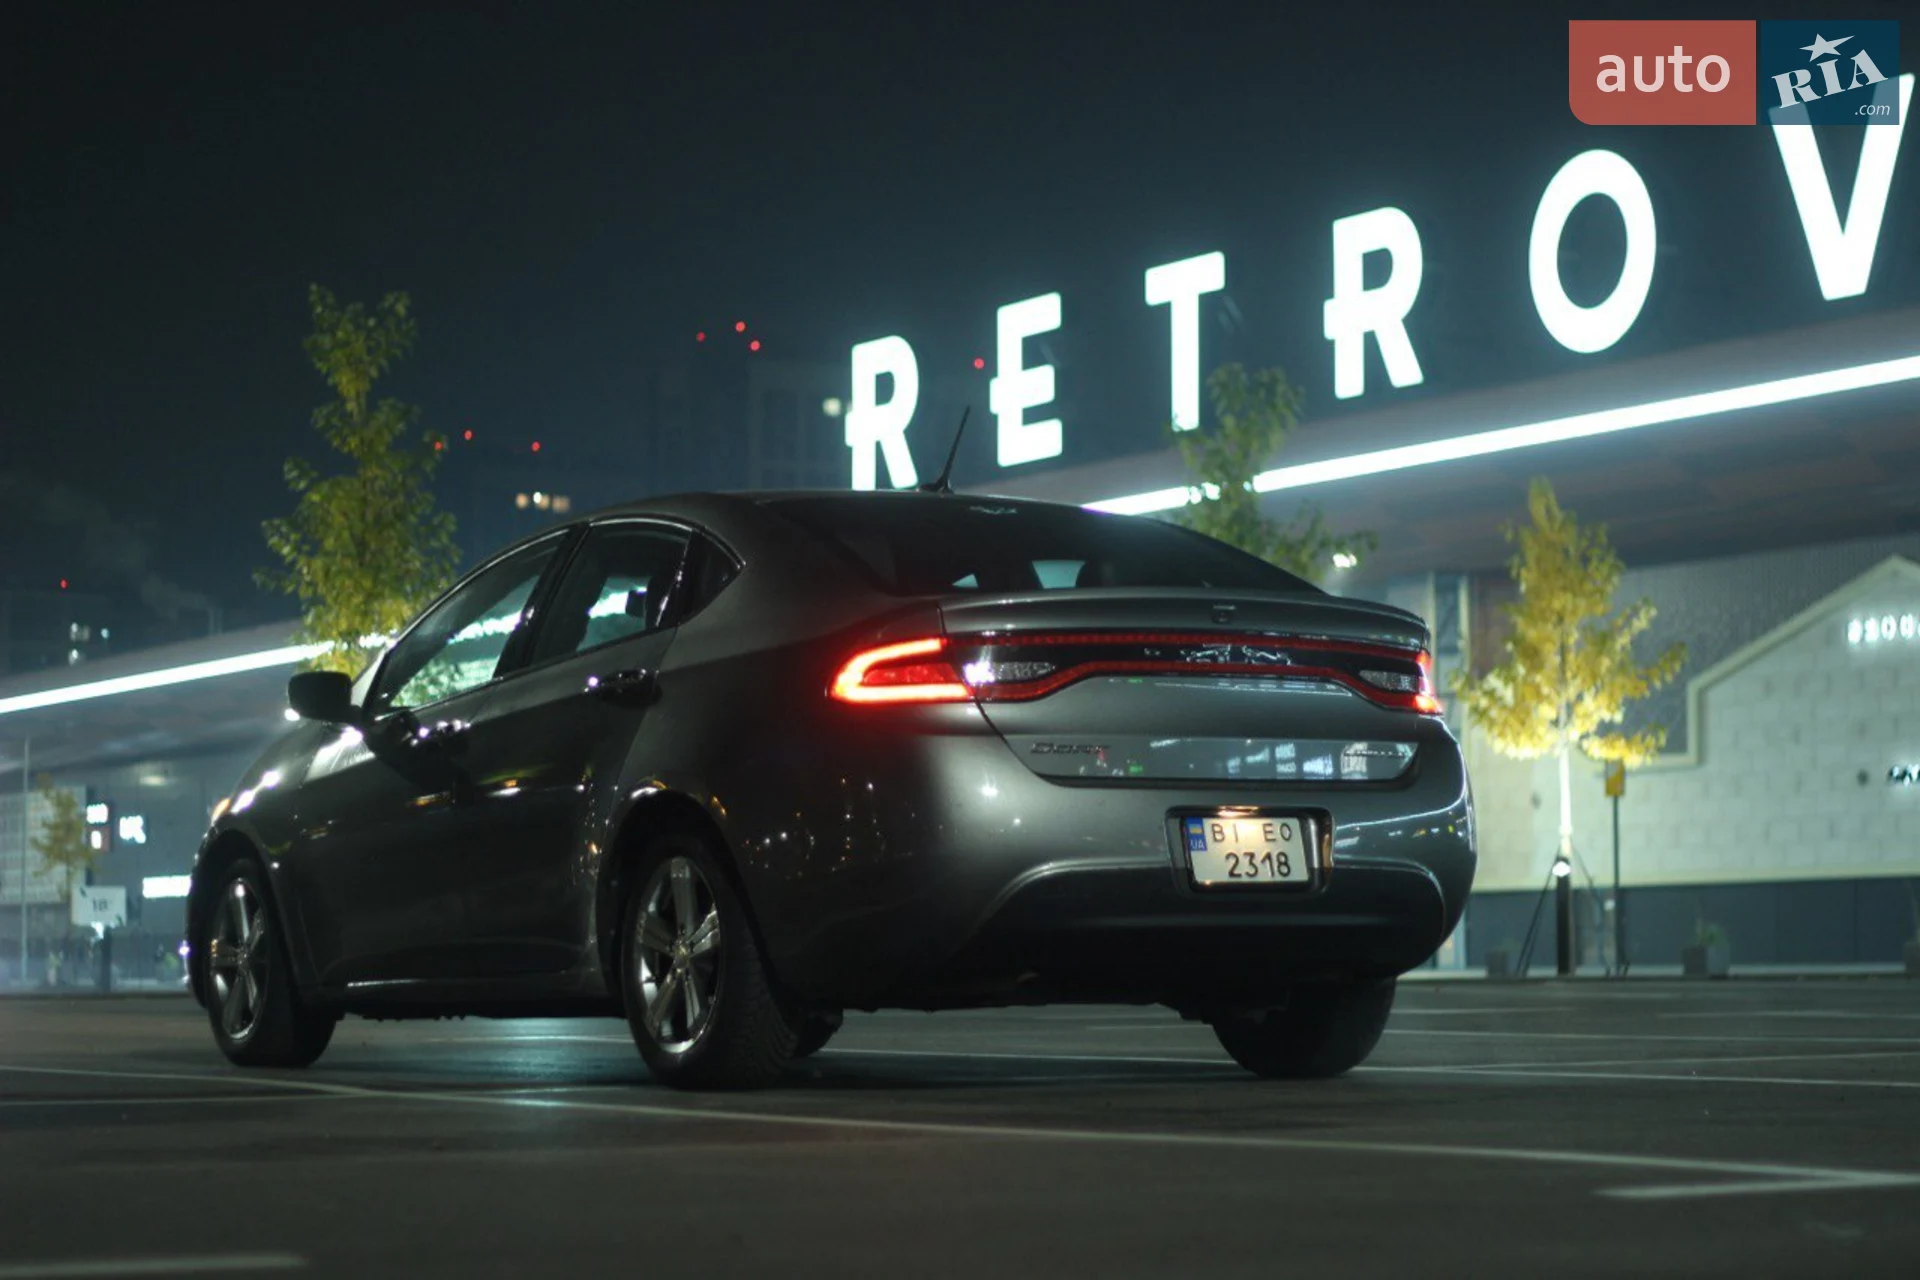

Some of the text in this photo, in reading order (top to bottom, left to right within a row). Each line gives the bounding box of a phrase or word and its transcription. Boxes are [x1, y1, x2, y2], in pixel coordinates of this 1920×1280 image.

[843, 72, 1916, 491] RETROV
[1190, 839, 1205, 850] UA
[1225, 851, 1291, 878] 2318
